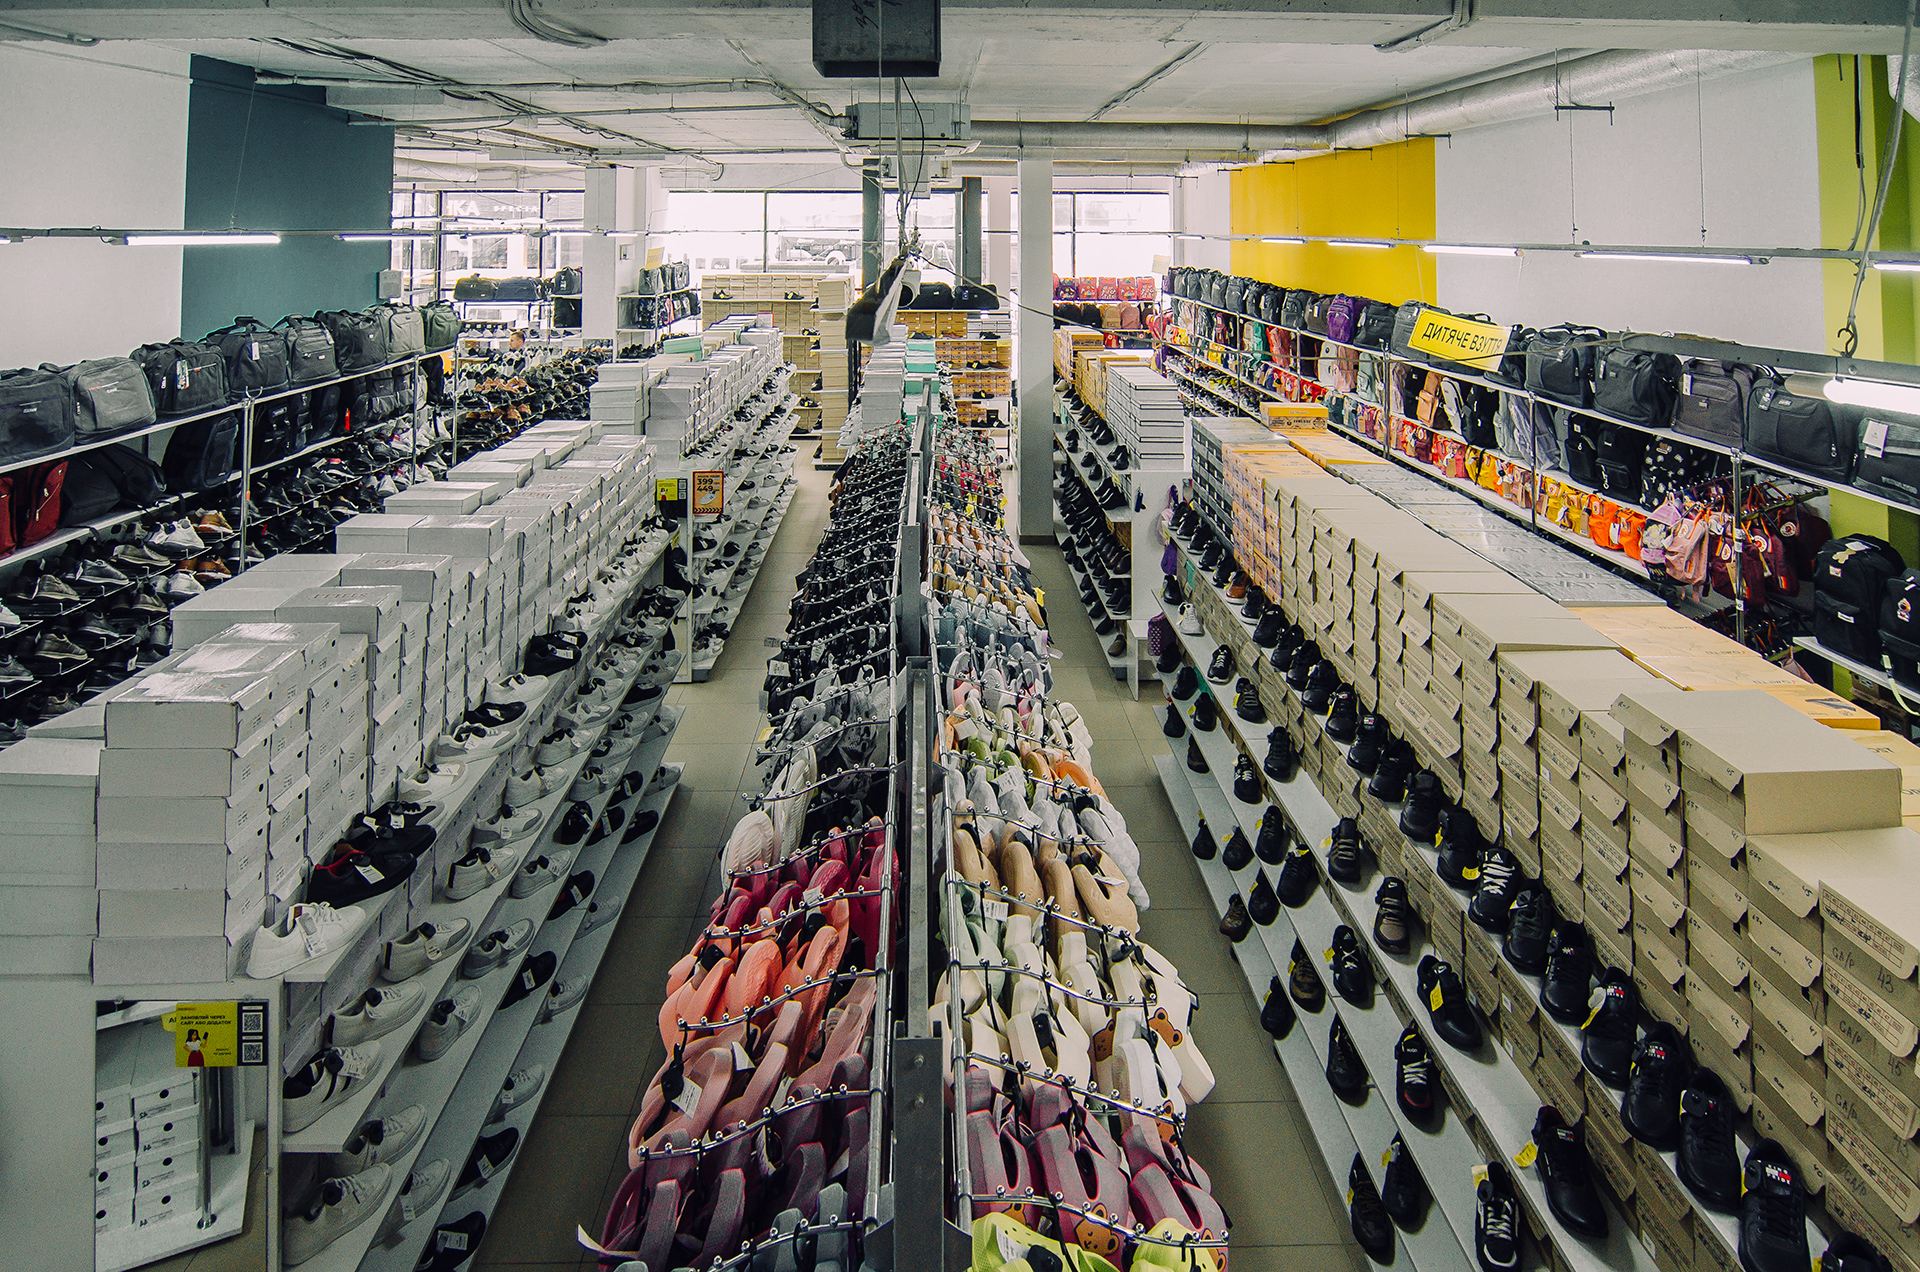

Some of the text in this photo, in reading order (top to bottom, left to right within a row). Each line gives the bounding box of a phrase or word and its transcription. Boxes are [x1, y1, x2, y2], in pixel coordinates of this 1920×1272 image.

[1422, 322, 1502, 354] ДИТЯЧЕ ВЗУТТЯ
[1805, 956, 1813, 968] 42
[1878, 967, 1894, 993] 43
[1768, 1164, 1788, 1174] KING
[1767, 1173, 1790, 1185] PRIDE
